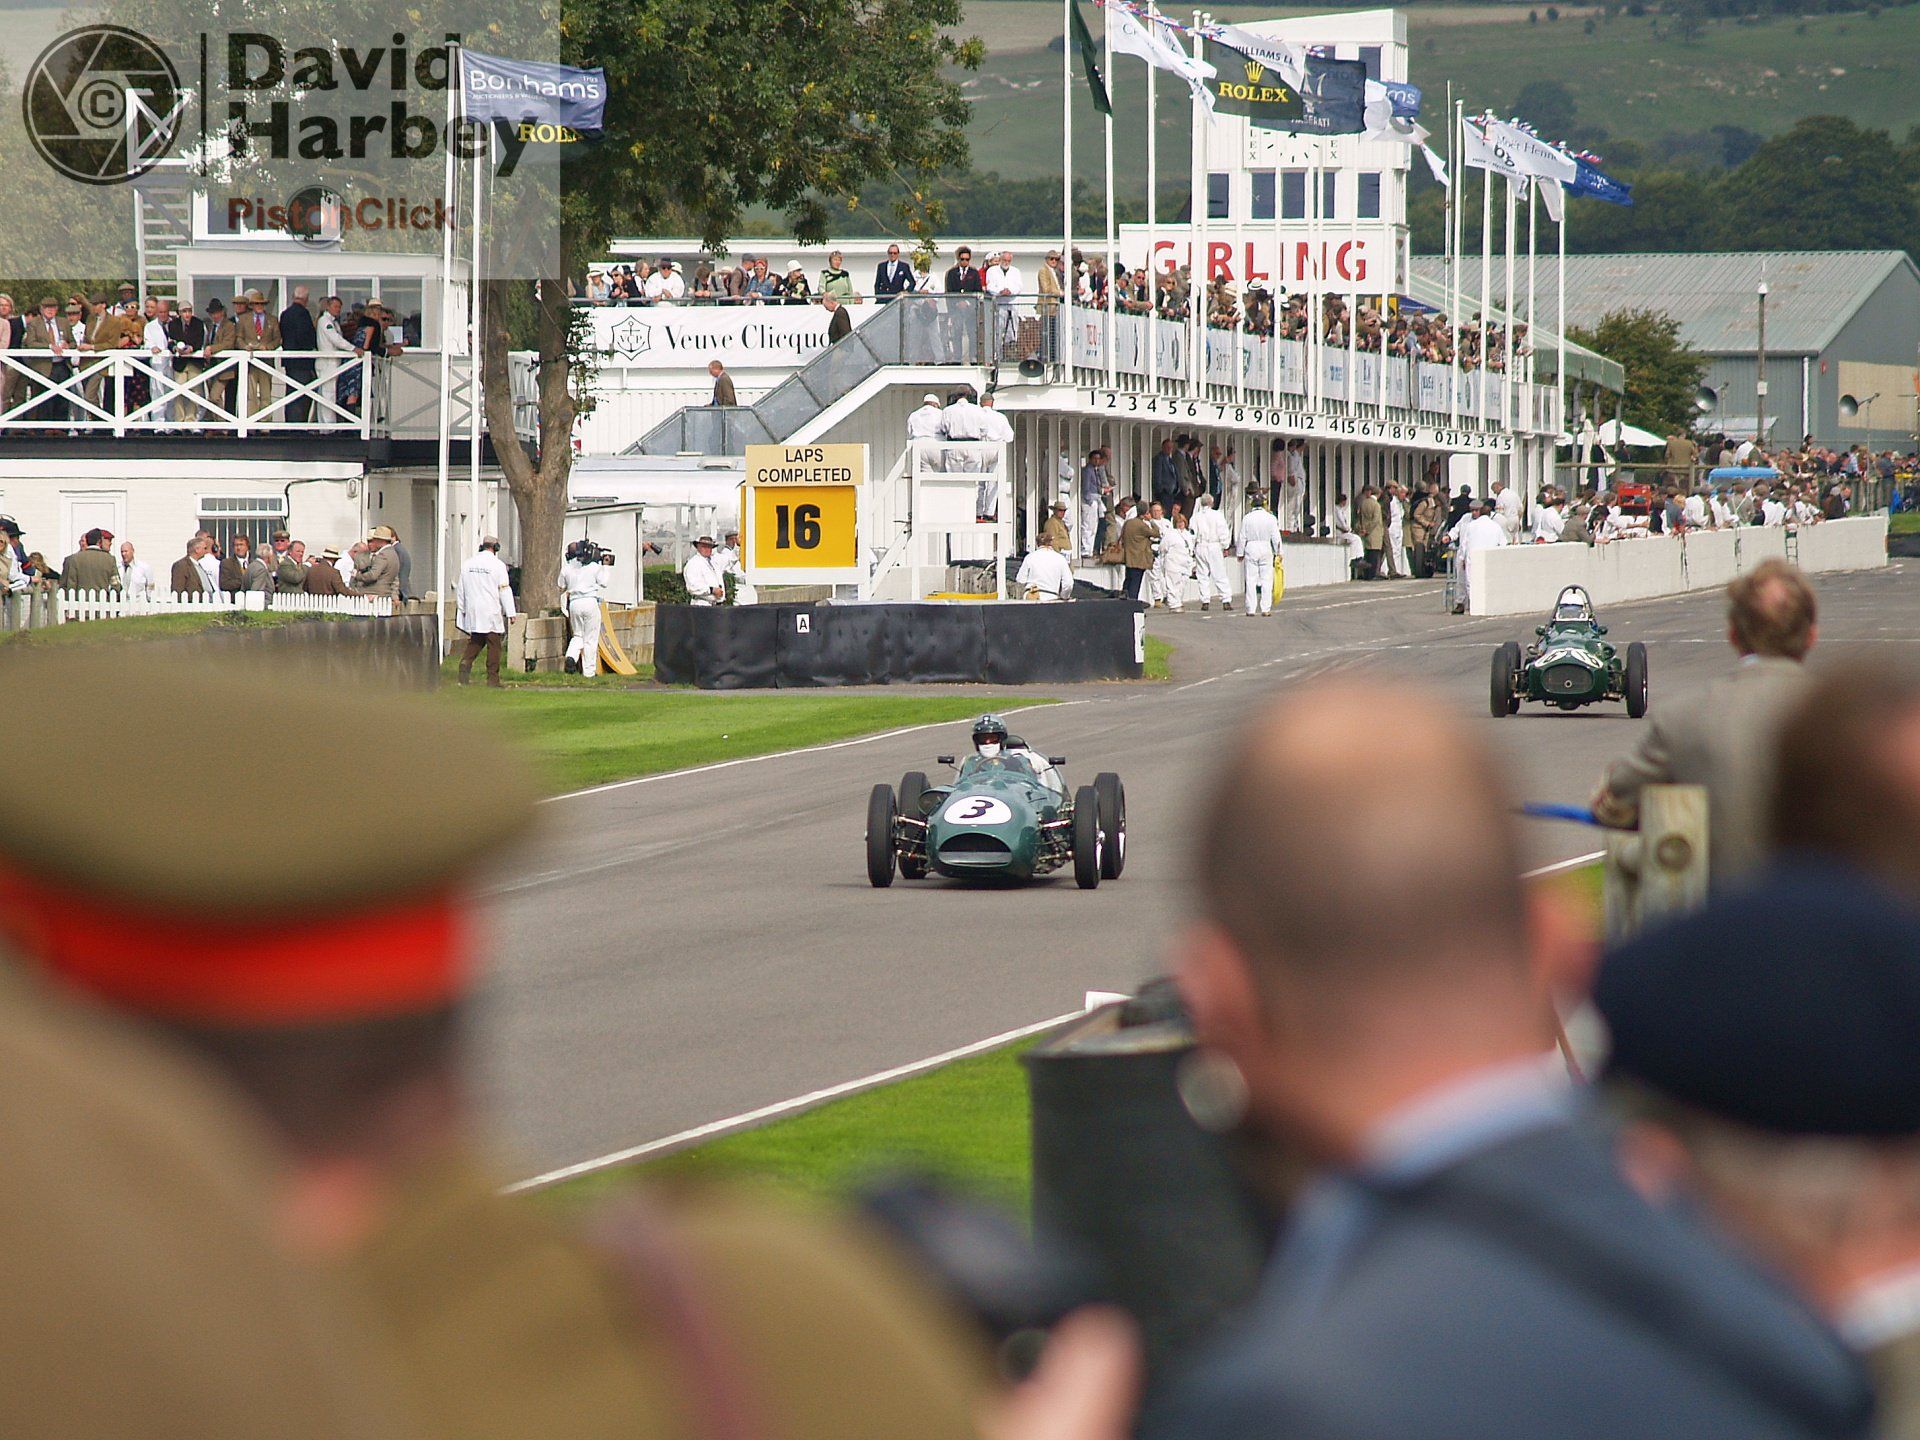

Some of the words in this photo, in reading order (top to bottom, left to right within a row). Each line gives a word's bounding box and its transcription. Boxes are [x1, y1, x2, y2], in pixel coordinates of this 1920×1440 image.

[470, 70, 600, 99] Bonhams
[1218, 82, 1289, 103] ROLEX
[518, 123, 579, 143] ROL
[664, 325, 733, 350] Veuve
[741, 324, 833, 354] Clicquo
[1107, 394, 1116, 408] 2
[1129, 397, 1137, 411] 3
[1147, 398, 1157, 412] 4
[1169, 401, 1177, 414] 5
[1187, 402, 1196, 416] 6
[1216, 406, 1225, 420] 7
[1235, 408, 1244, 421] 8
[1254, 410, 1262, 423] 9
[1288, 414, 1298, 427] 11
[1301, 416, 1314, 429] 12
[1342, 420, 1355, 433] 15
[785, 448, 824, 463] LAPS
[757, 468, 851, 482] COMPLETED
[776, 504, 821, 549] 16
[798, 616, 808, 630] A
[959, 799, 995, 819] 3
